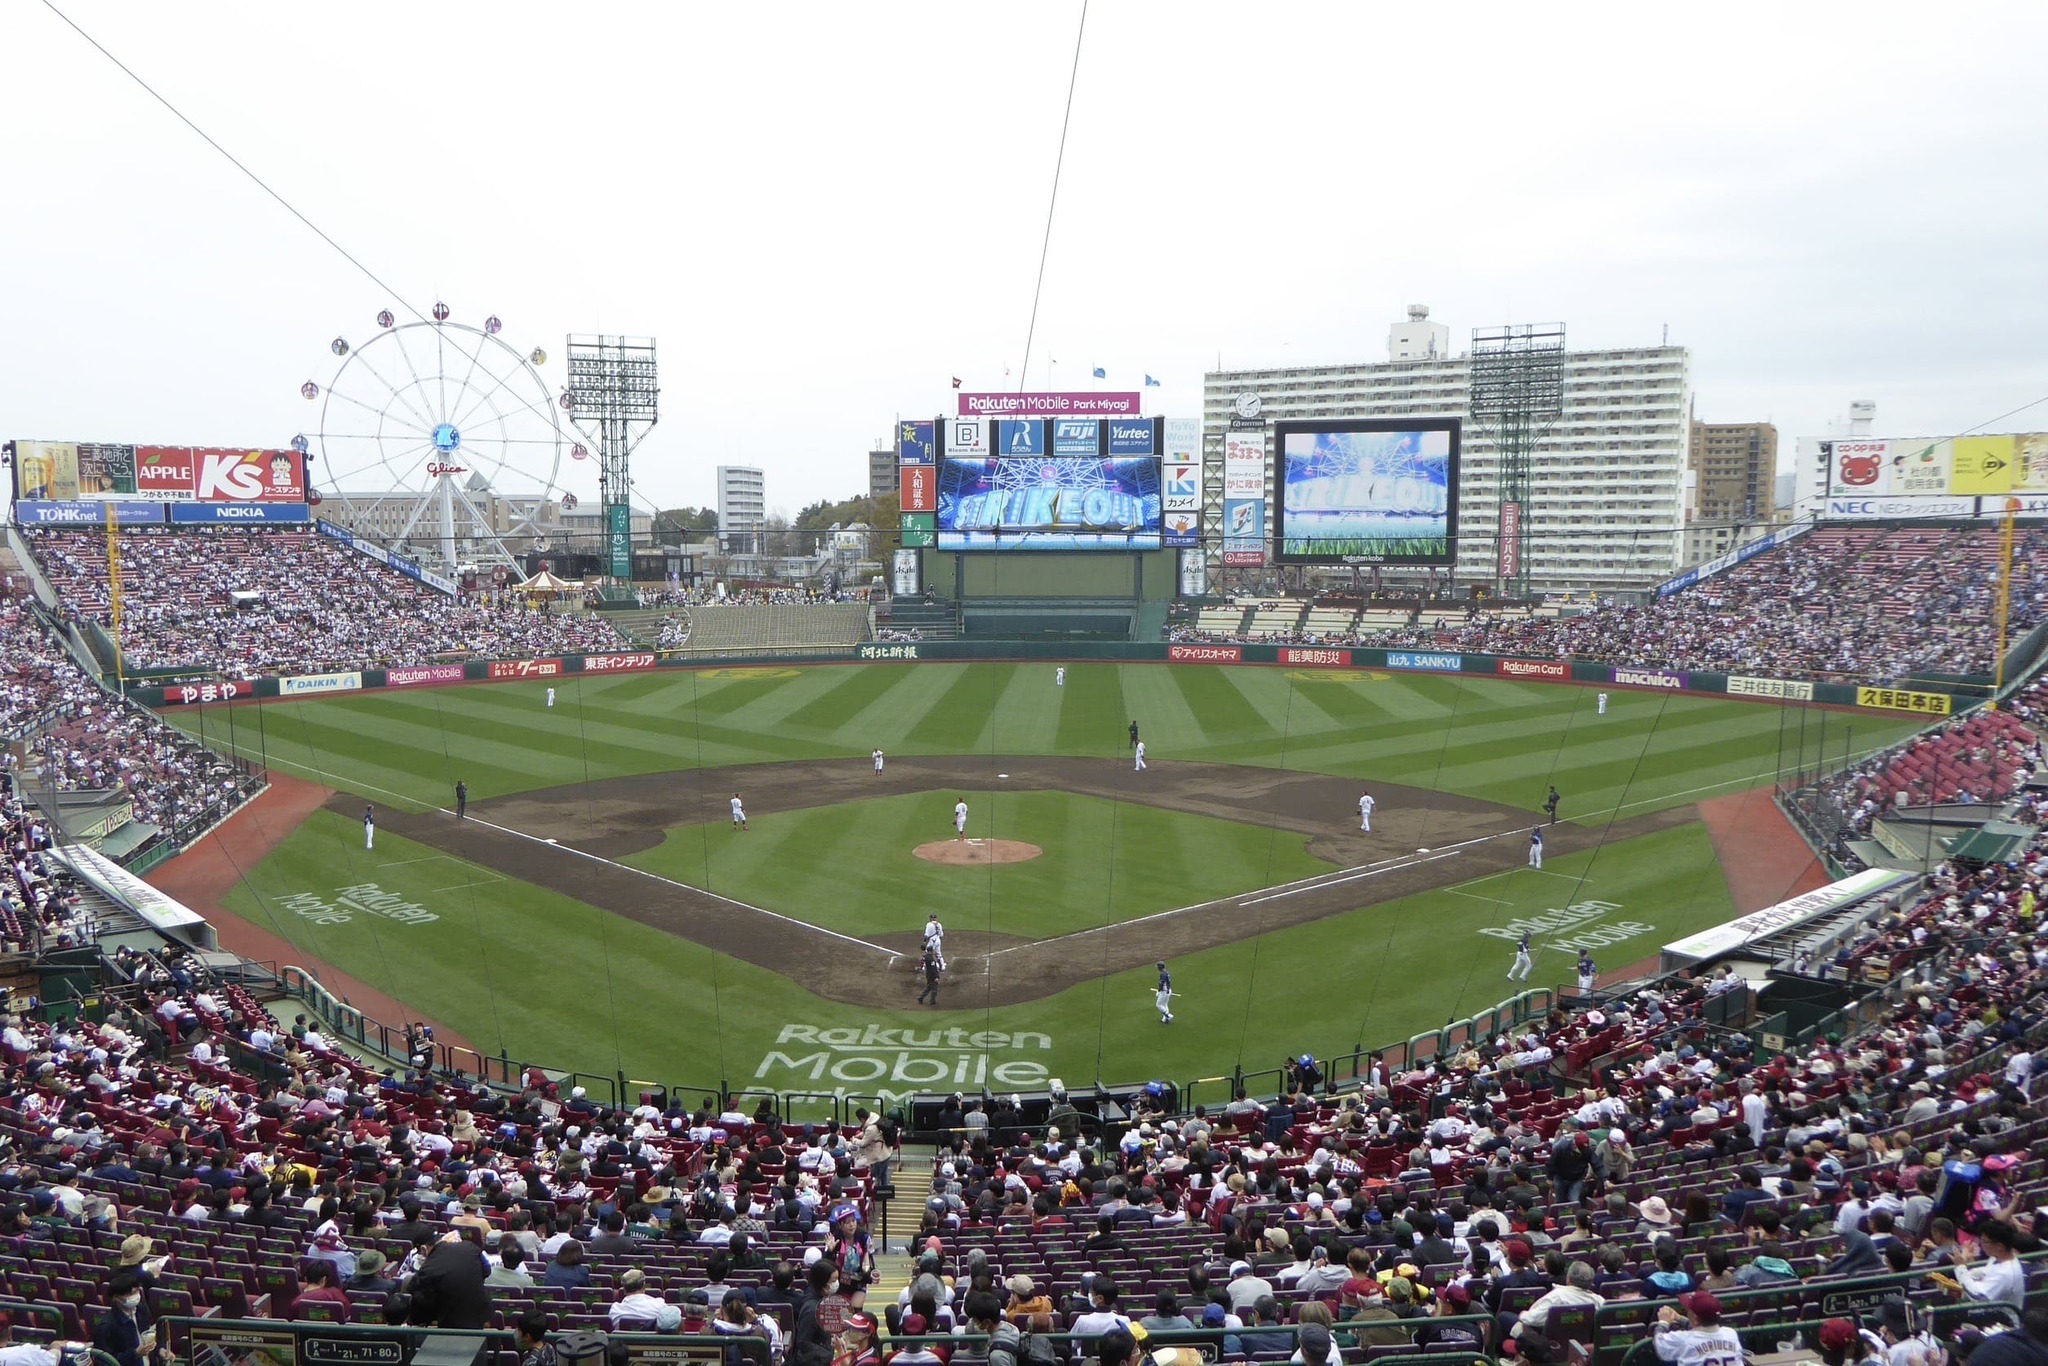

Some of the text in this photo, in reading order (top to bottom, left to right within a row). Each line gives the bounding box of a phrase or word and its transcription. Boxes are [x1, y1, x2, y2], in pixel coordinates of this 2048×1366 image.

[968, 397, 1130, 410] Rakuten Mobile Park Miyagi
[1057, 423, 1096, 440] Fuji
[1112, 422, 1150, 438] Yurtec
[81, 448, 131, 462] 三菱地所と
[1227, 442, 1263, 459] まるまつ
[82, 462, 132, 476] 次にいこう。
[139, 466, 191, 480] APPLE
[426, 463, 467, 477] Glico
[264, 486, 301, 494] ケーズデンキ
[912, 469, 923, 509] 大和証券
[1227, 480, 1262, 488] かに政宗
[1905, 479, 1945, 489] 信用金庫
[141, 491, 192, 499] つがるや不動産
[1168, 498, 1194, 507] カメイ
[1831, 502, 1875, 514] NEC
[216, 507, 265, 517] NOKIA
[1504, 505, 1514, 574] 三井のリハウス
[1343, 555, 1367, 563] Rakuten
[895, 566, 915, 574] Asahi
[1184, 566, 1203, 574] Asahi
[861, 646, 918, 659] 河北新報
[1183, 648, 1236, 659] アイリスオーヤマ
[1287, 649, 1340, 664] 能美防災
[585, 655, 654, 670] 東京インテリア
[1388, 654, 1461, 668] 山九 SANKYU
[1503, 661, 1563, 675] Rakuten Card
[389, 667, 461, 683] Rakuten Mobile
[297, 679, 338, 689] DAIKIN
[1730, 679, 1810, 699] 三井住友銀行
[181, 685, 238, 704] やまや
[1864, 690, 1945, 712] 久保田本店
[1476, 900, 1624, 940] Rakuten
[1540, 920, 1656, 954] Mobile
[776, 1024, 1052, 1049] Rakuten
[754, 1051, 1049, 1085] Mobile
